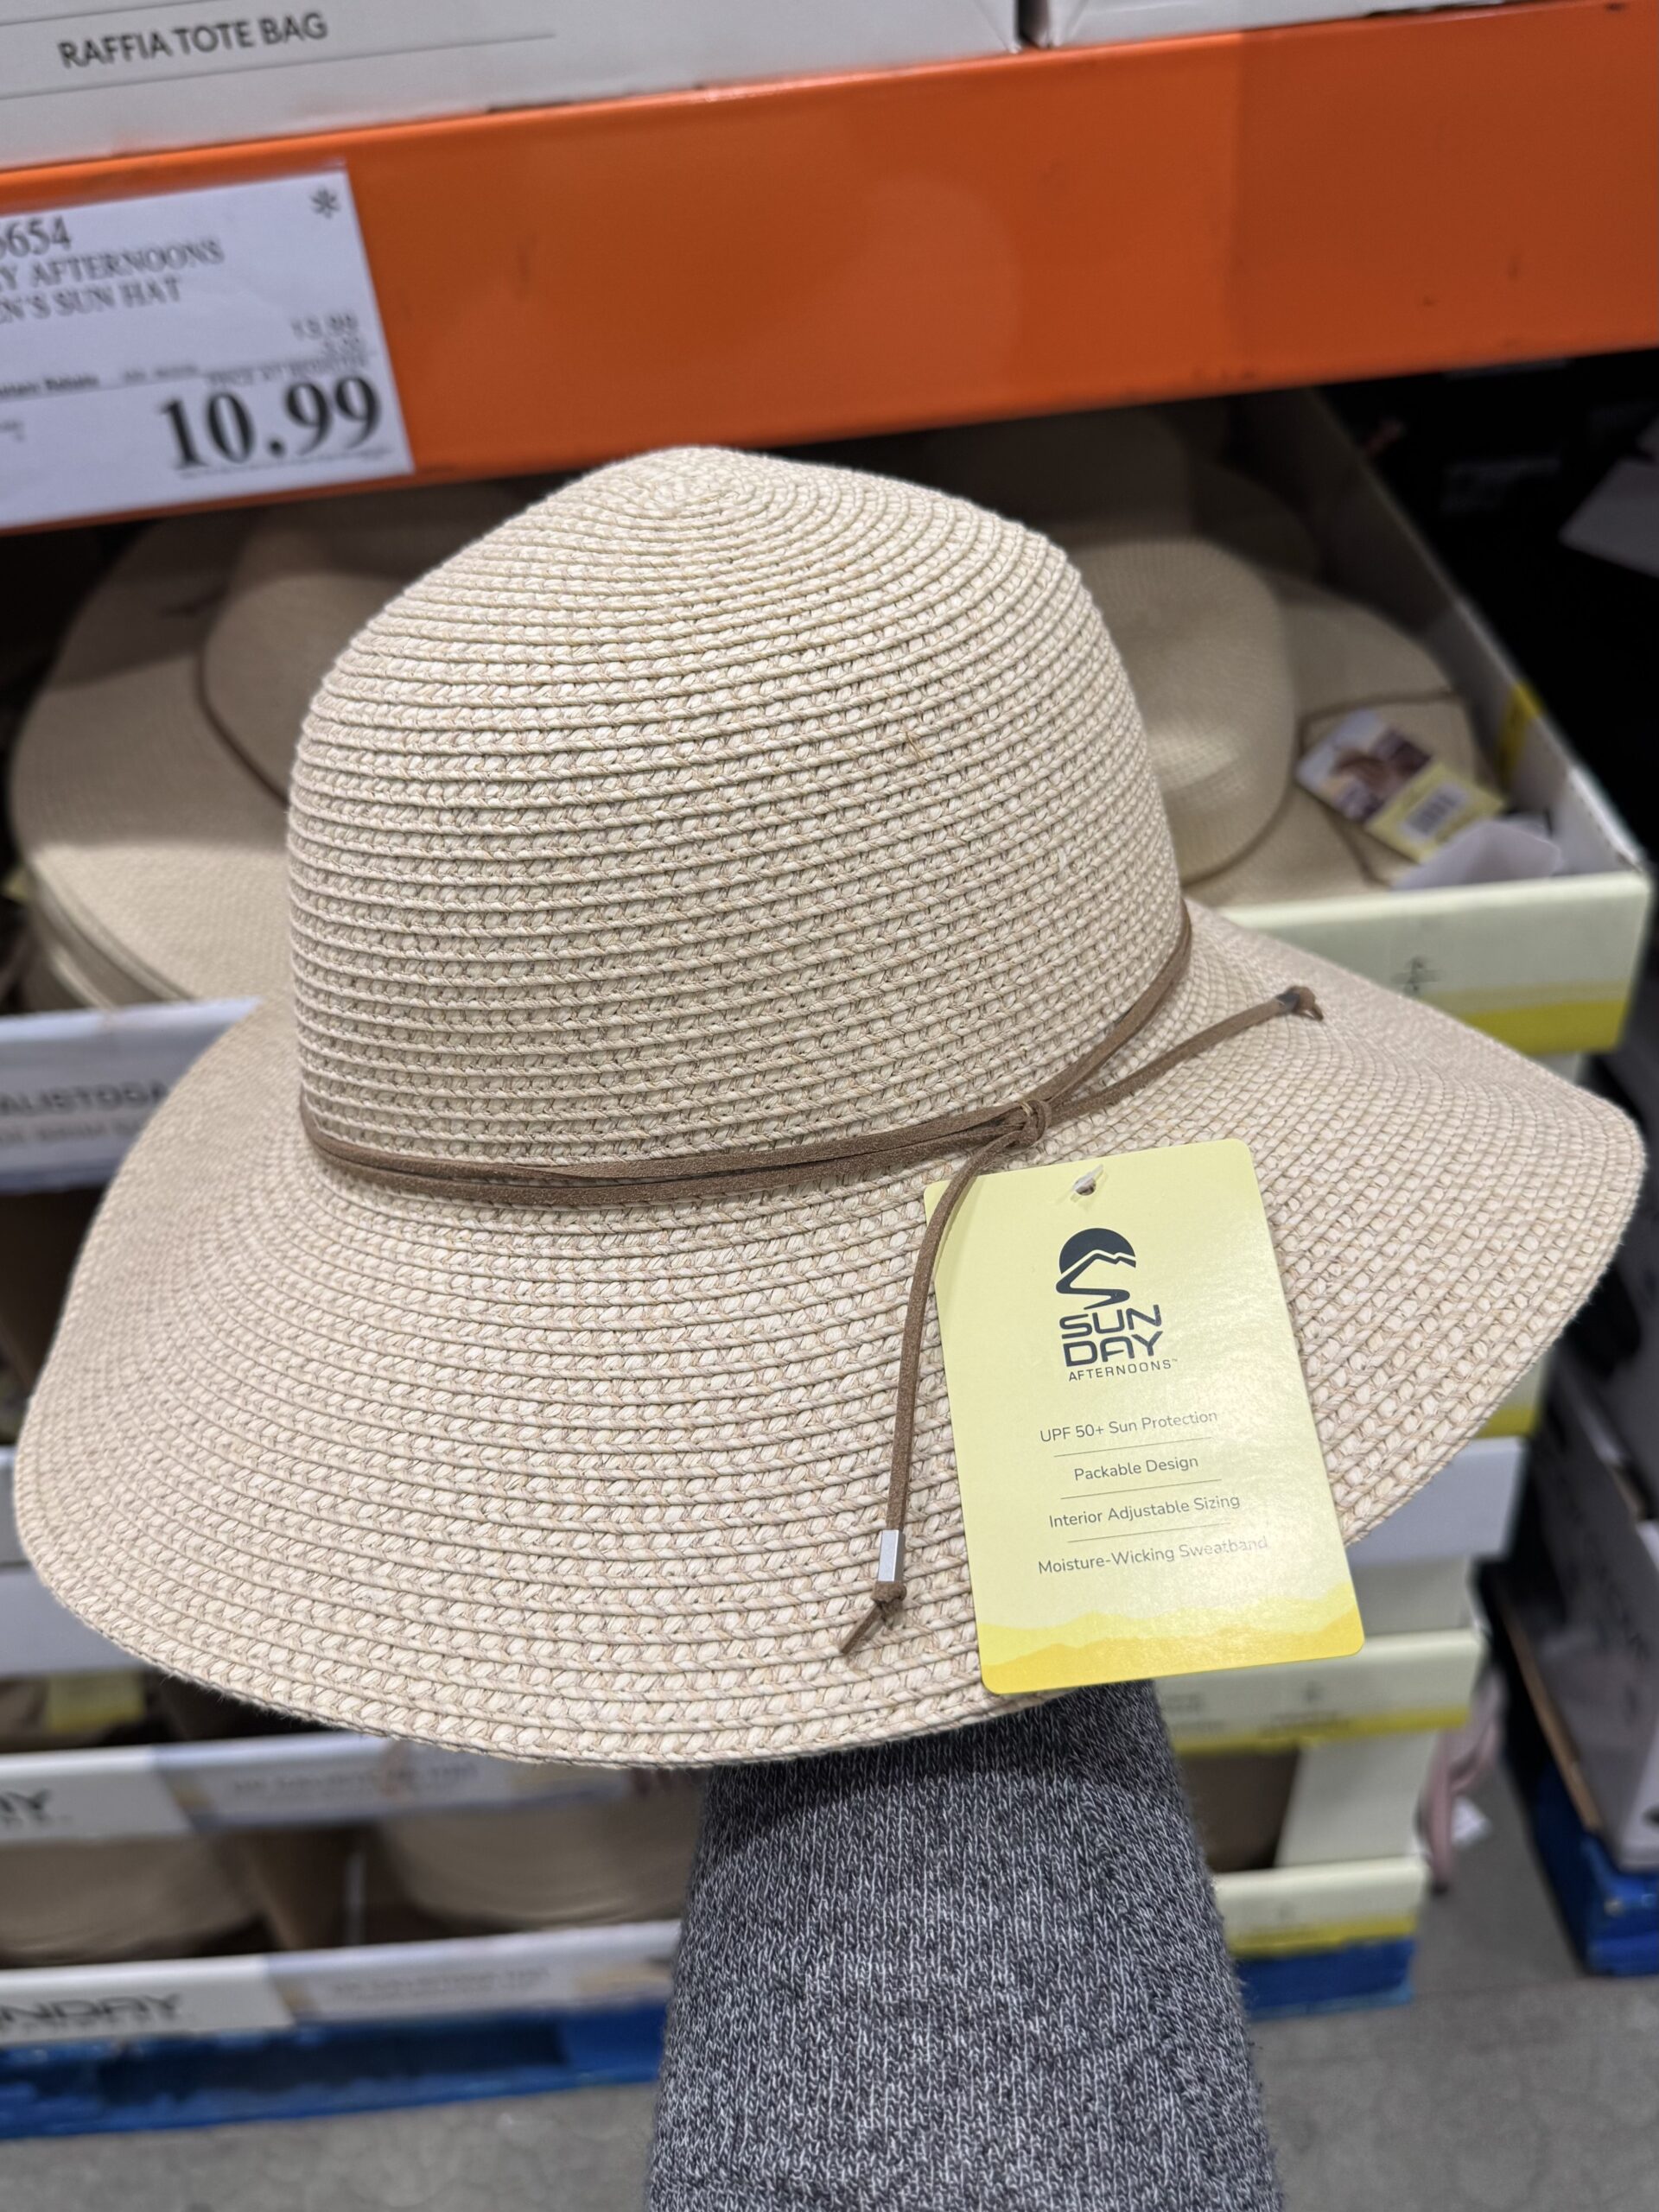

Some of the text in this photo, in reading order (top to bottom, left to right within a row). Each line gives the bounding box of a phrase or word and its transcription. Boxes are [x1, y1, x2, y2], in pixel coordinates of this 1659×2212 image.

[58, 11, 329, 69] RAFFIA TOTE BAG
[30, 234, 226, 289] AFTERNOONS
[53, 287, 117, 317] SUN
[119, 275, 181, 308] HAT
[162, 375, 381, 471] 10.99
[1059, 1305, 1162, 1339] SUN
[1063, 1331, 1163, 1367] DAY
[1040, 1412, 1218, 1442] UPF 50+ Sun Protection
[1074, 1457, 1198, 1481] Packable Design
[1049, 1495, 1241, 1528] Interior Adjustable Sizing
[1038, 1535, 1268, 1574] Moisture-Wicking Sweatband
